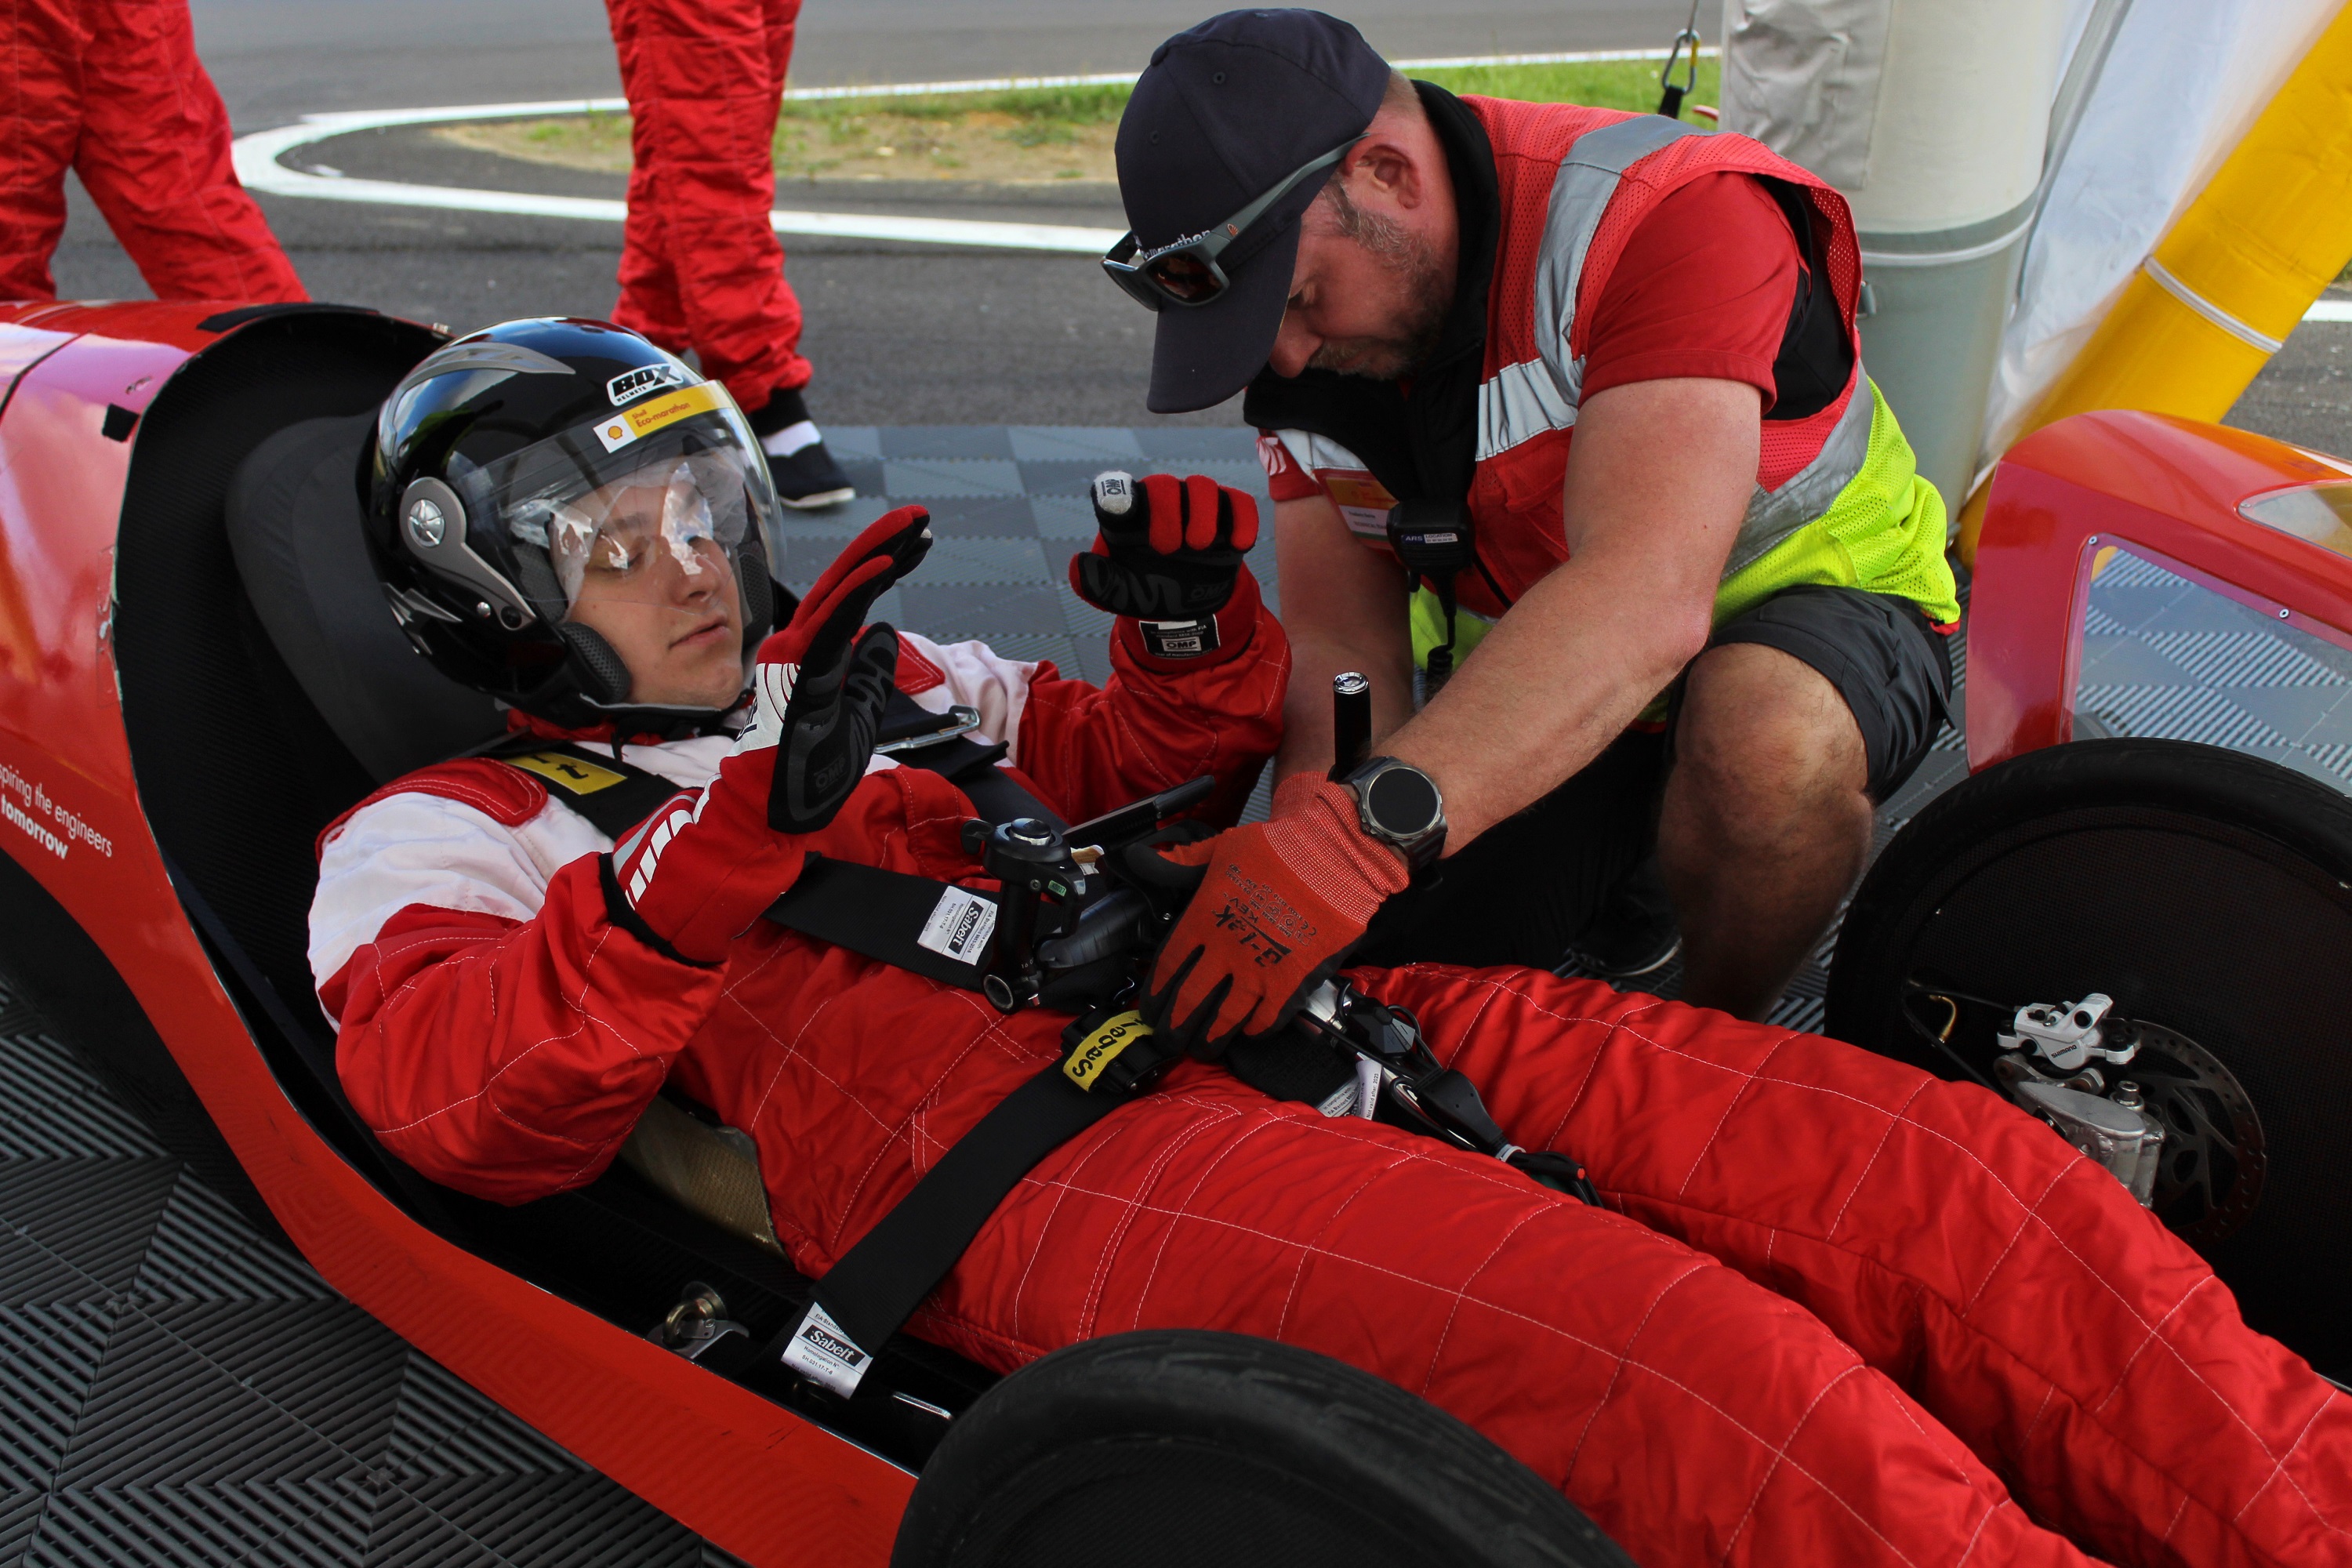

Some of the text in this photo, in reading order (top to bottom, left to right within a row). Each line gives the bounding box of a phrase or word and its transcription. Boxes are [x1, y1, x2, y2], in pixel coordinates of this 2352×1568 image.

[612, 365, 681, 397] BOX
[616, 385, 648, 403] HELMETS
[632, 409, 648, 419] Shell
[636, 401, 691, 428] Eco-marathon
[1166, 641, 1197, 649] OMP
[1, 793, 68, 860] tomorrow
[34, 782, 53, 815] the
[55, 806, 112, 858] engineers
[1229, 897, 1259, 924] KEV
[953, 907, 979, 946] Sabelt
[2051, 1044, 2078, 1058] SHIMANO
[804, 1345, 834, 1365] Homologation
[810, 1330, 855, 1362] Sabelt
